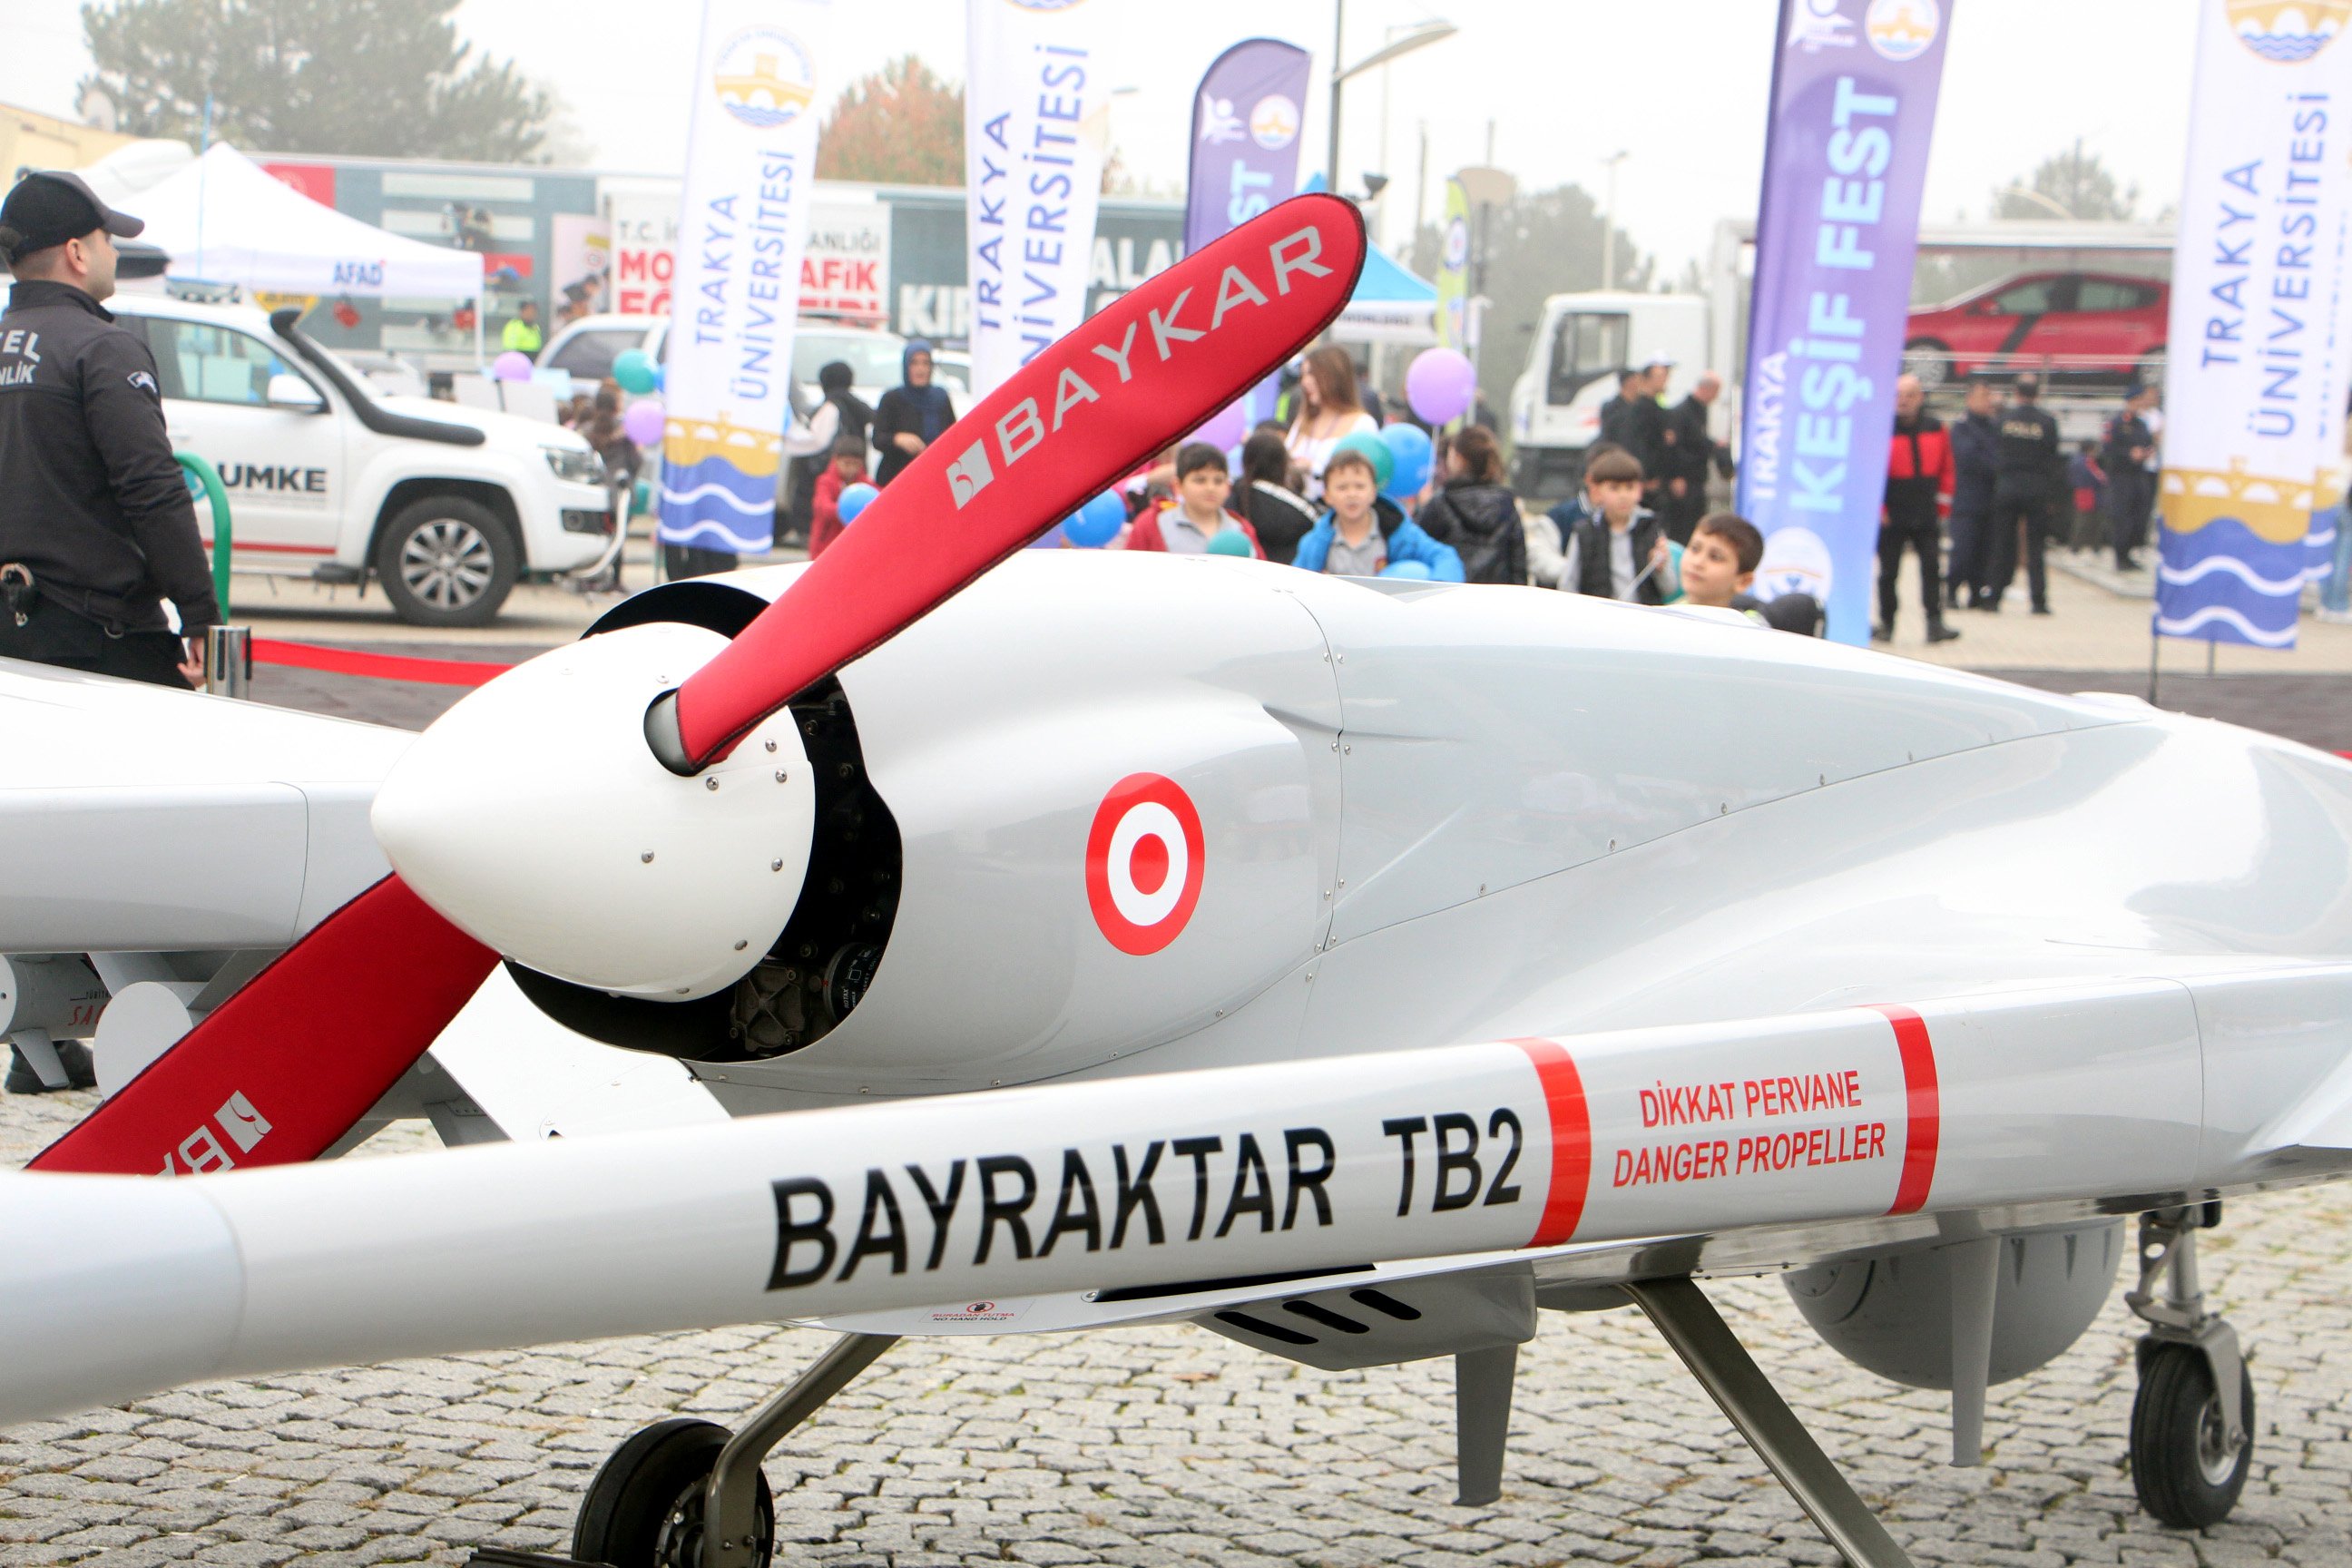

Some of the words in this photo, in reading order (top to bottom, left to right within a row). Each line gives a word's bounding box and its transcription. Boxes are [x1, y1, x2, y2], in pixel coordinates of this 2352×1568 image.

[976, 111, 1012, 329] TRAKYA
[1014, 44, 1089, 368] NİVERSİTESİ
[1228, 159, 1274, 227] ST
[1817, 76, 1898, 270] FEST
[0, 329, 41, 362] EL
[332, 261, 382, 286] AFAD
[620, 249, 675, 283] MO
[800, 257, 879, 292] AFİK
[695, 193, 739, 346] TRAKYA
[730, 149, 796, 400] ÜNİVERSİTESİ
[995, 225, 1333, 467] BAYKAR
[2200, 158, 2264, 370] TRAKYA
[2245, 90, 2330, 439] ÜNİVERSİTESİ
[218, 462, 328, 493] UMKE
[1749, 349, 1788, 501] TRAKYA
[1788, 289, 1874, 514] KEŞİF
[1613, 1140, 1729, 1188] DANGER
[1735, 1122, 1886, 1176] PROPELLER
[1639, 1080, 1735, 1128] DİKKAT
[1744, 1070, 1862, 1119] PERVANE
[766, 1127, 1335, 1291] BAYRAKTAR
[1382, 1107, 1523, 1217] TB2
